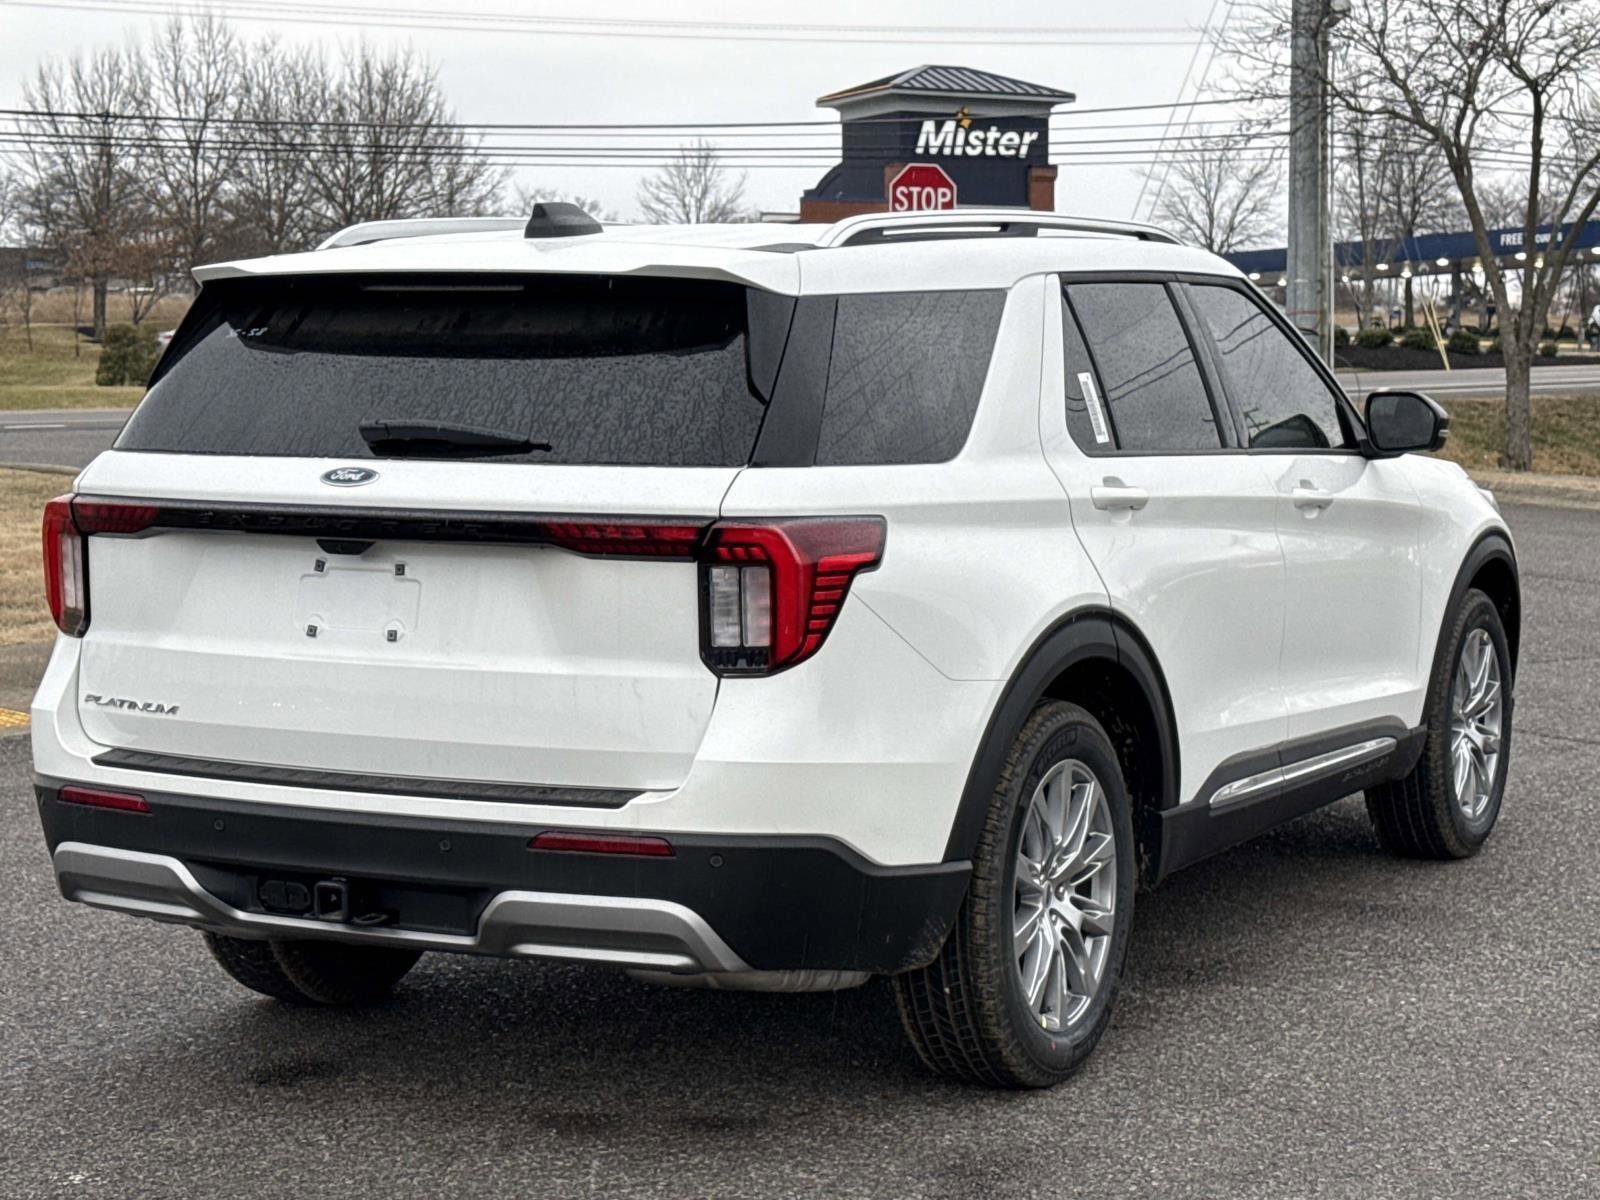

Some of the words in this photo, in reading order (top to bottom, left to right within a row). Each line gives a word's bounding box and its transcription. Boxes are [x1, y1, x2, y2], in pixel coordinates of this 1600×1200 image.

[915, 119, 1039, 159] Mister
[894, 185, 952, 211] STOP
[1500, 232, 1523, 246] FREE
[330, 469, 366, 481] Ford
[84, 693, 180, 715] PLATINUM
